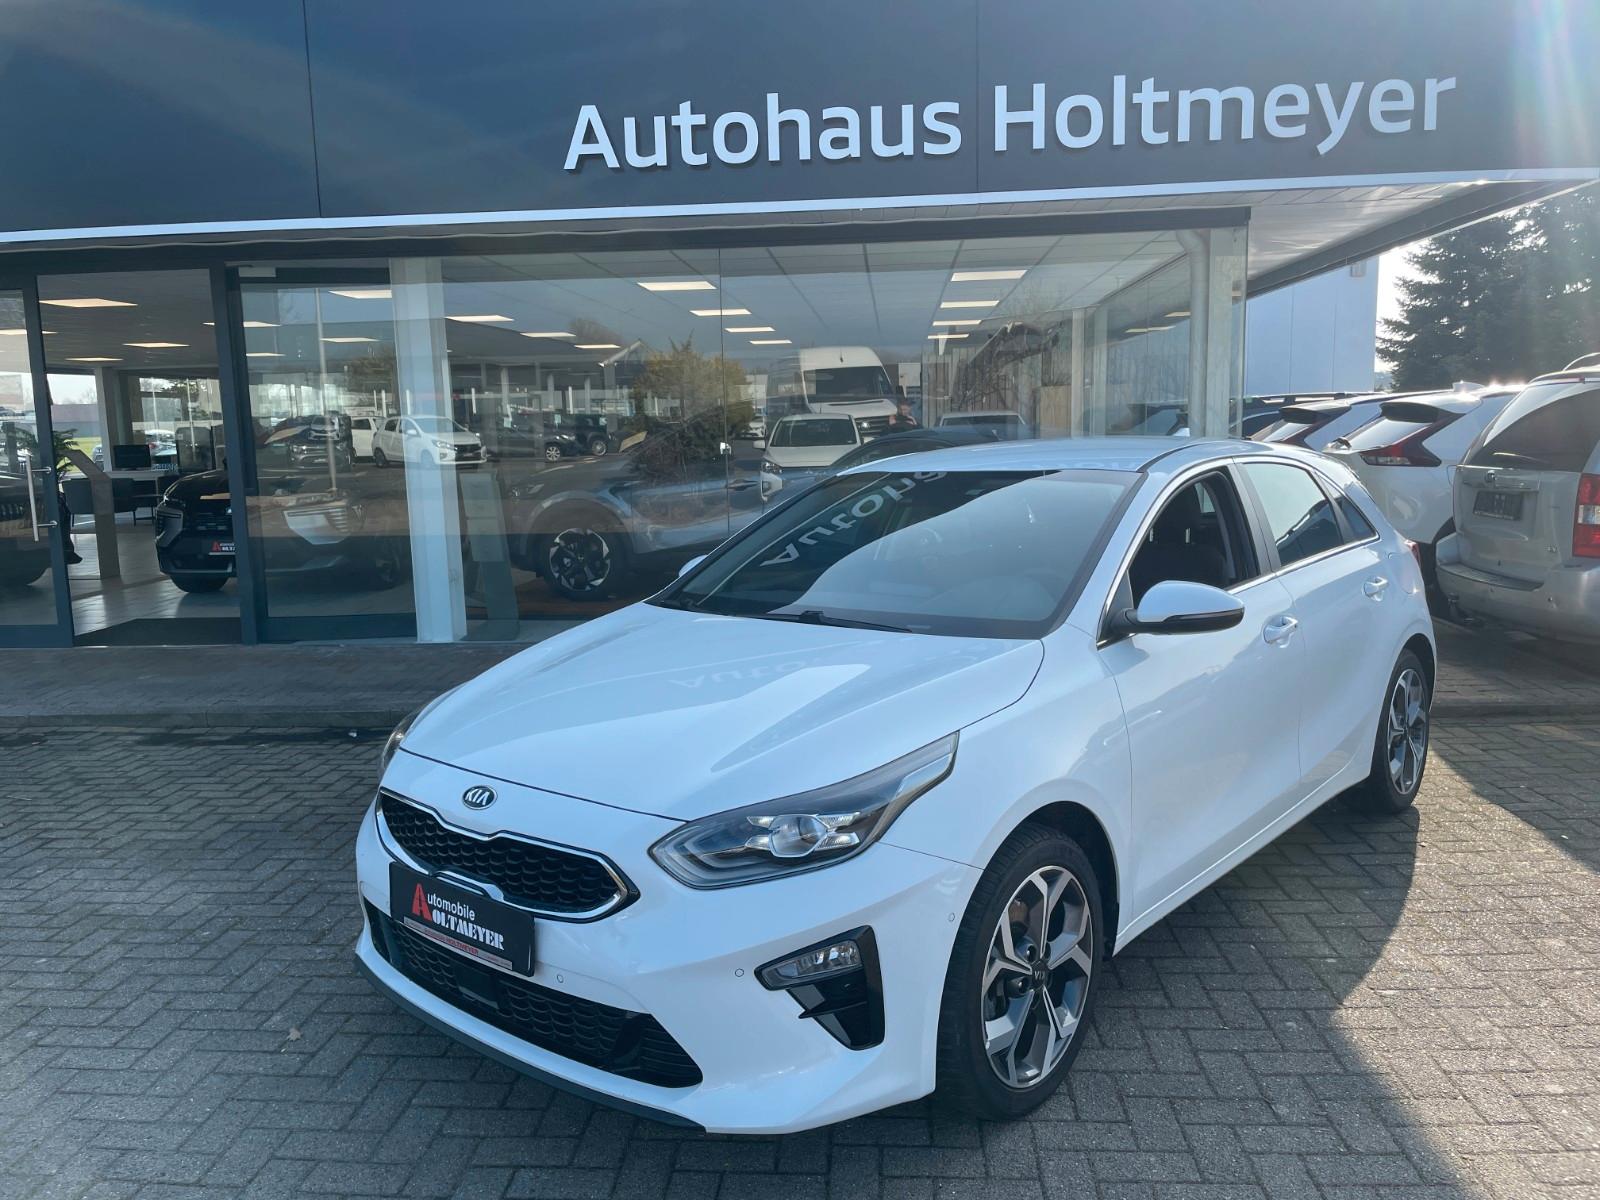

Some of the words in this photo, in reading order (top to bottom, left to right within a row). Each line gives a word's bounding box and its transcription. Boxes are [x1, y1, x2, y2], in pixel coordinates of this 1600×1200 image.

[563, 92, 963, 172] Autohaus
[993, 75, 1458, 156] Holtmeyer
[464, 788, 490, 806] KIA
